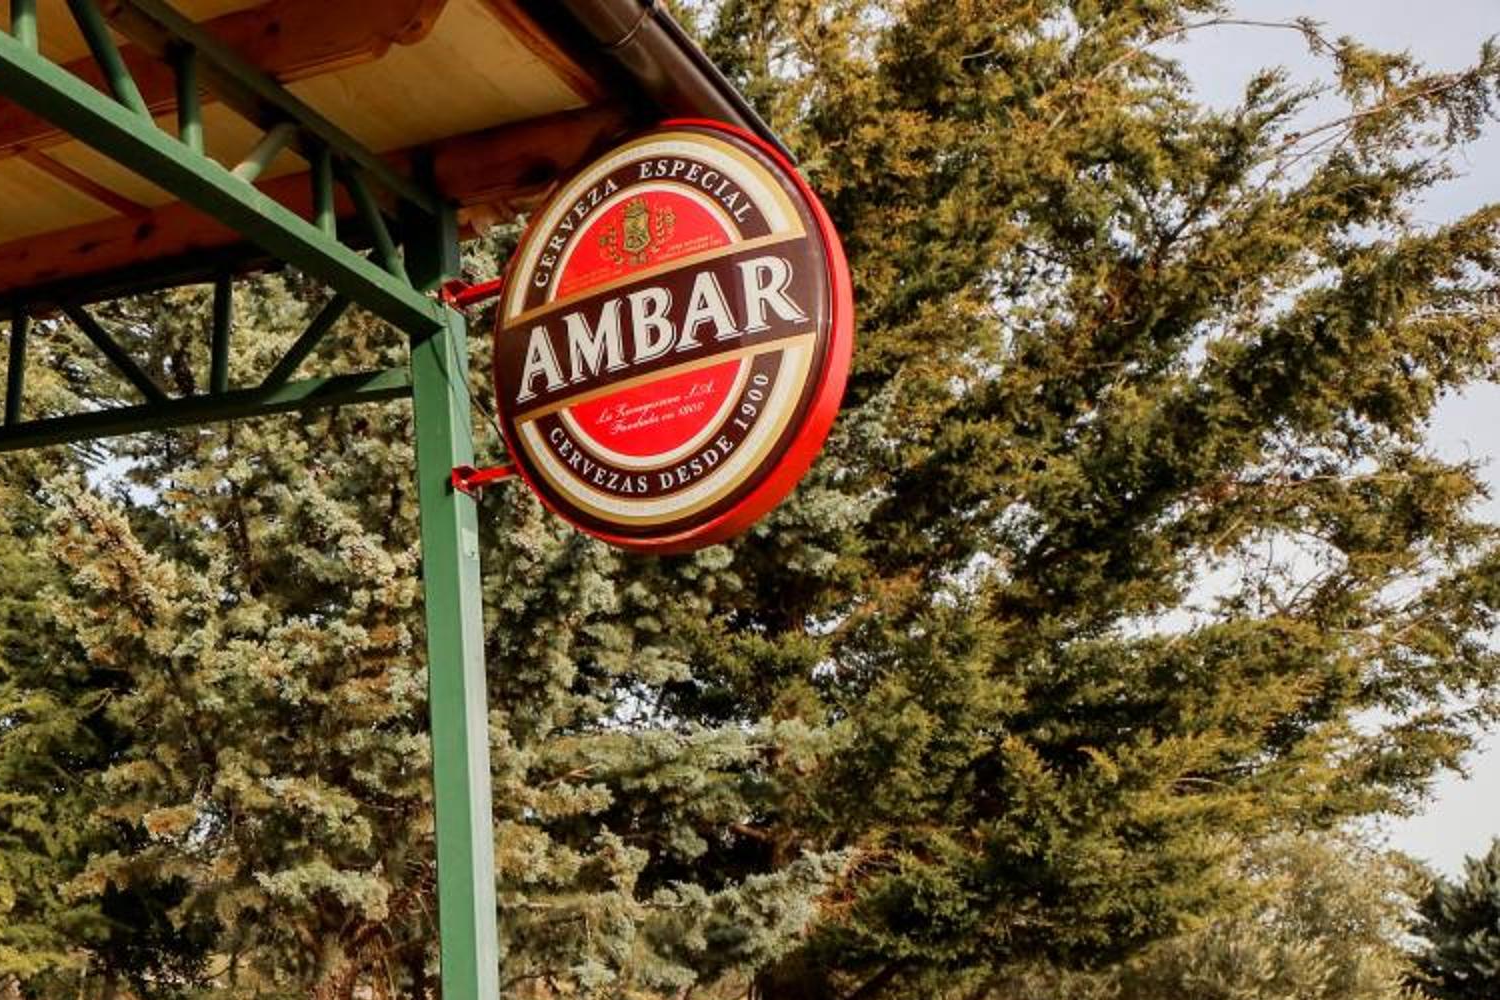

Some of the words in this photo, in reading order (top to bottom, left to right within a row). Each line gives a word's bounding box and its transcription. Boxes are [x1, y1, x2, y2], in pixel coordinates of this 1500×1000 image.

[534, 178, 619, 288] CERVEZA
[638, 159, 752, 224] ESPECIAL
[516, 255, 810, 402] AMBAR
[549, 426, 649, 493] CERVEZAS
[659, 438, 735, 490] DESDE
[734, 373, 769, 432] 1900
